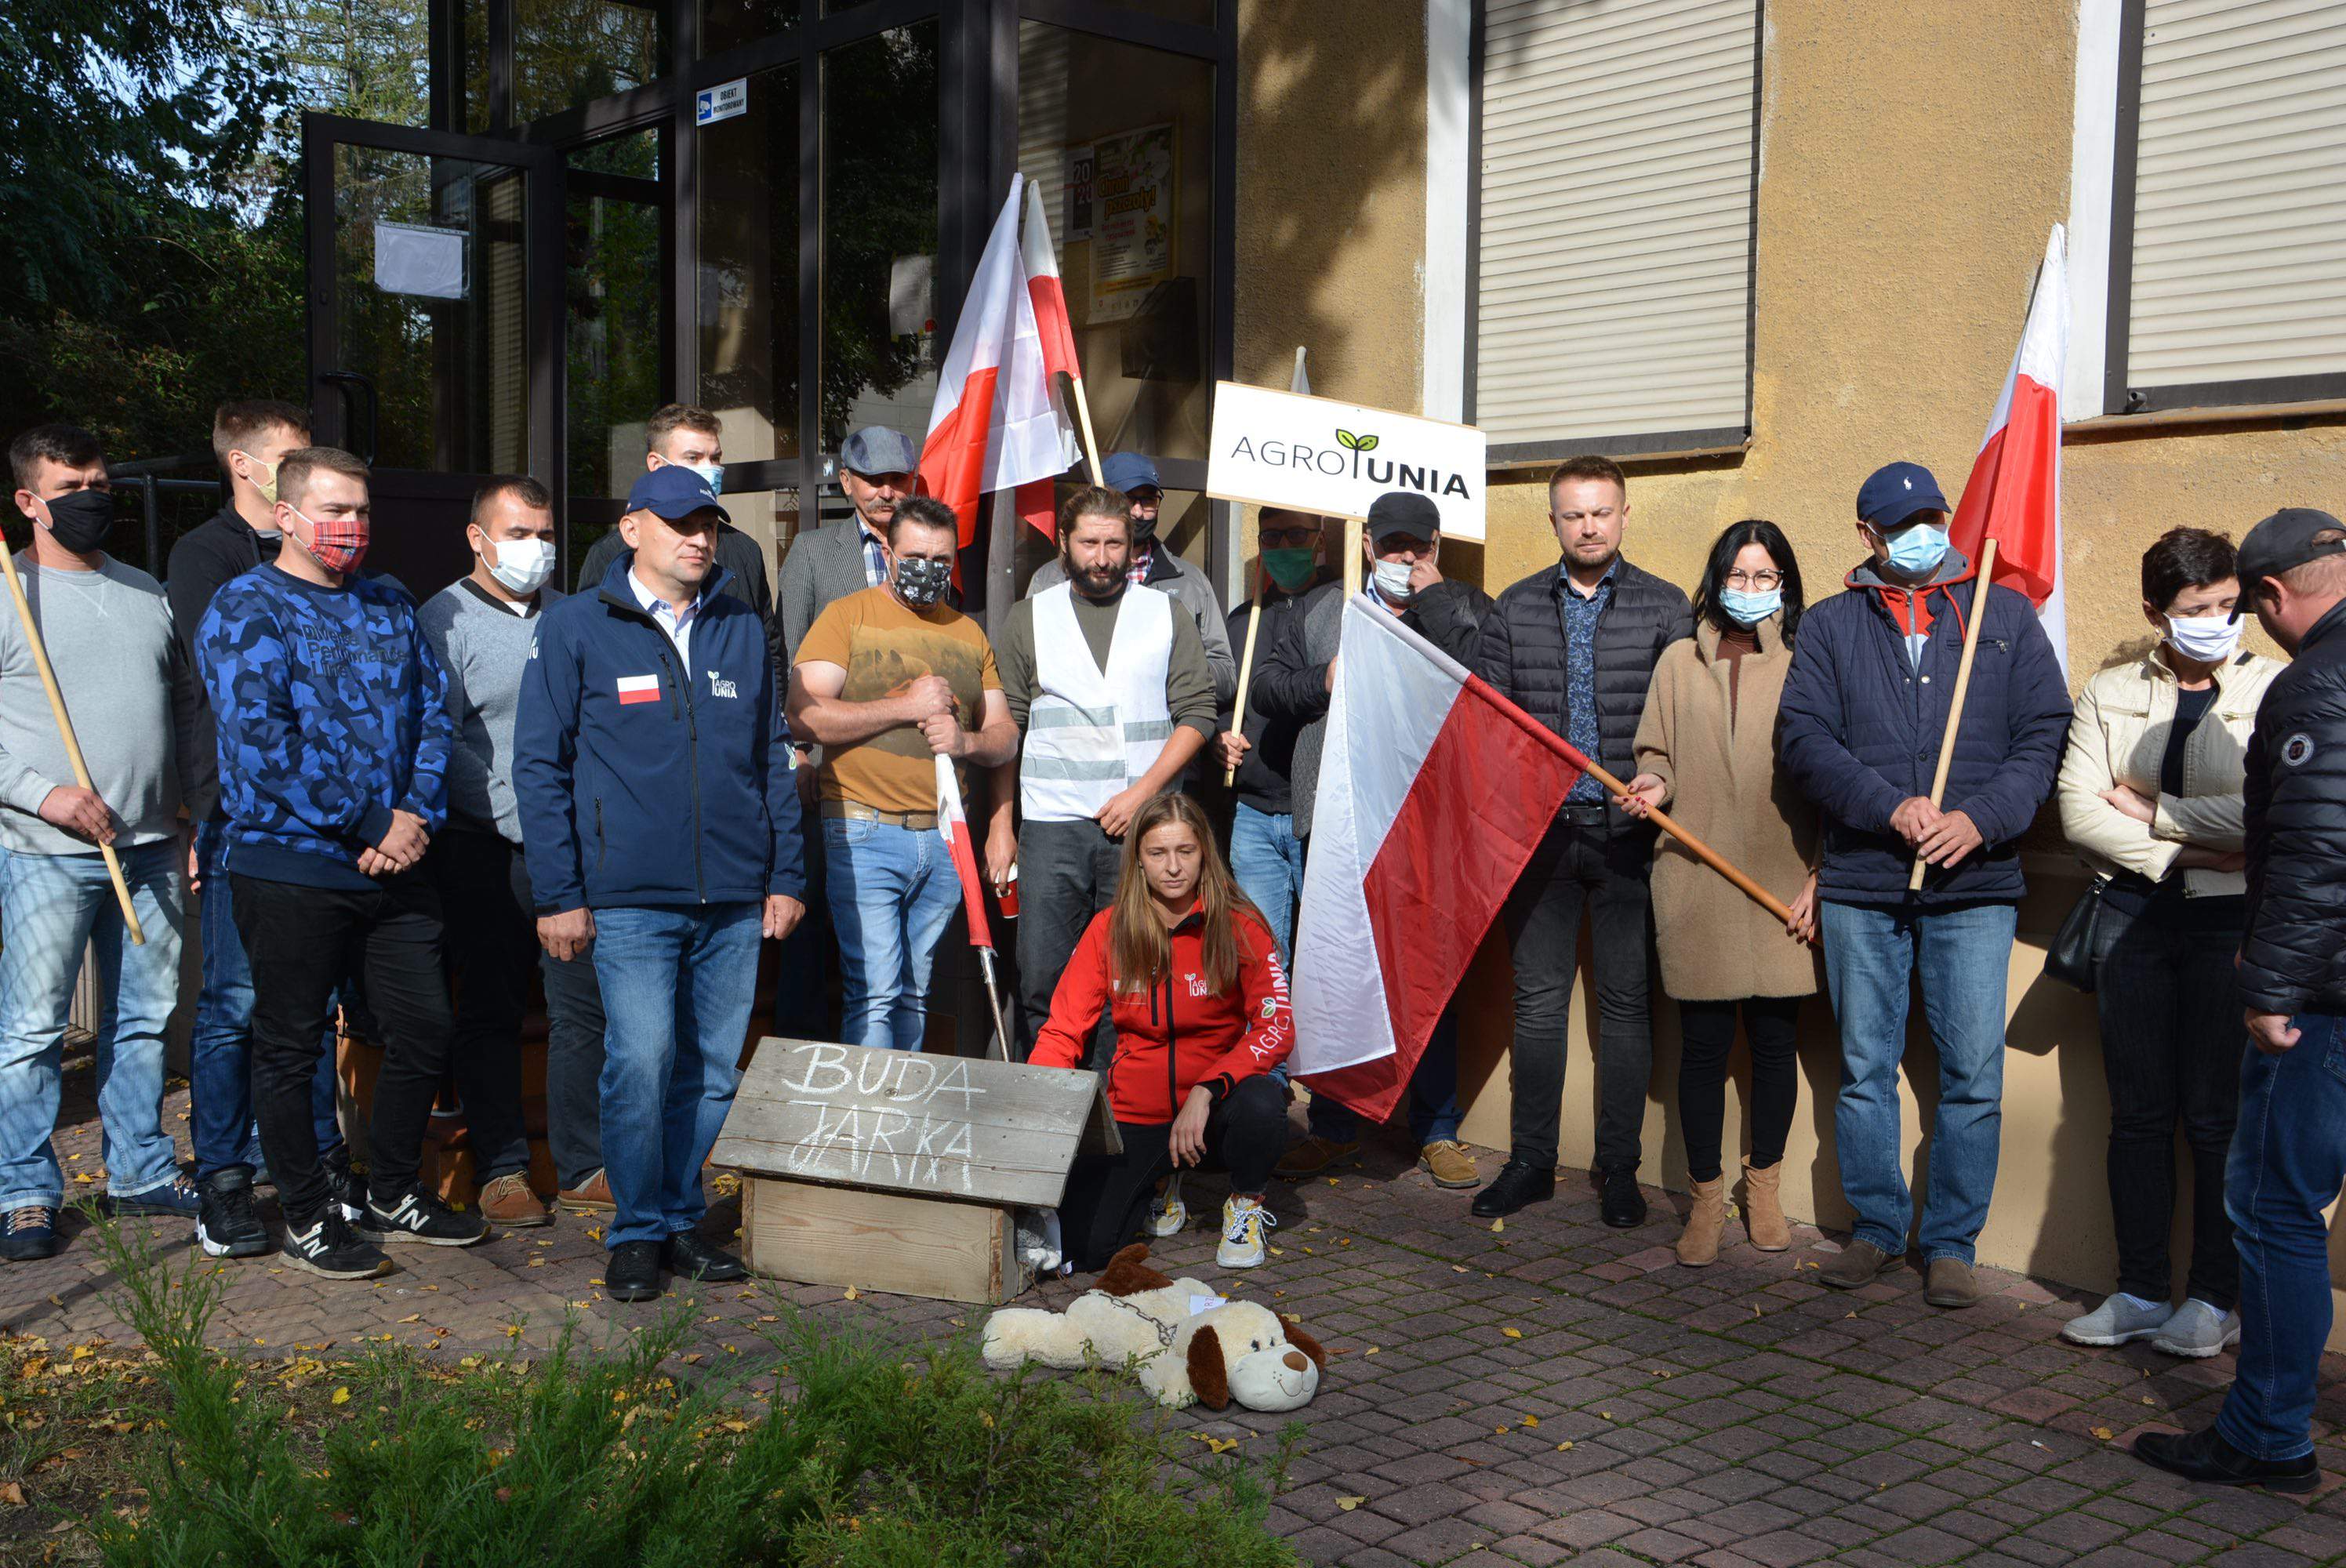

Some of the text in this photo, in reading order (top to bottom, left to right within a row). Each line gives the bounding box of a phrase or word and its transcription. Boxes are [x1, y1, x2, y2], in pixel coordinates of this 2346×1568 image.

[721, 88, 737, 100] OBIEKT
[713, 99, 744, 114] MONITOROWANY
[1073, 162, 1090, 184] 20
[1097, 170, 1129, 198] Chroń
[1103, 186, 1157, 220] pszczoły!
[714, 680, 736, 689] AGRO
[714, 688, 738, 699] UNIA
[781, 1043, 987, 1112] BUDA
[787, 1100, 974, 1192] JARKA
